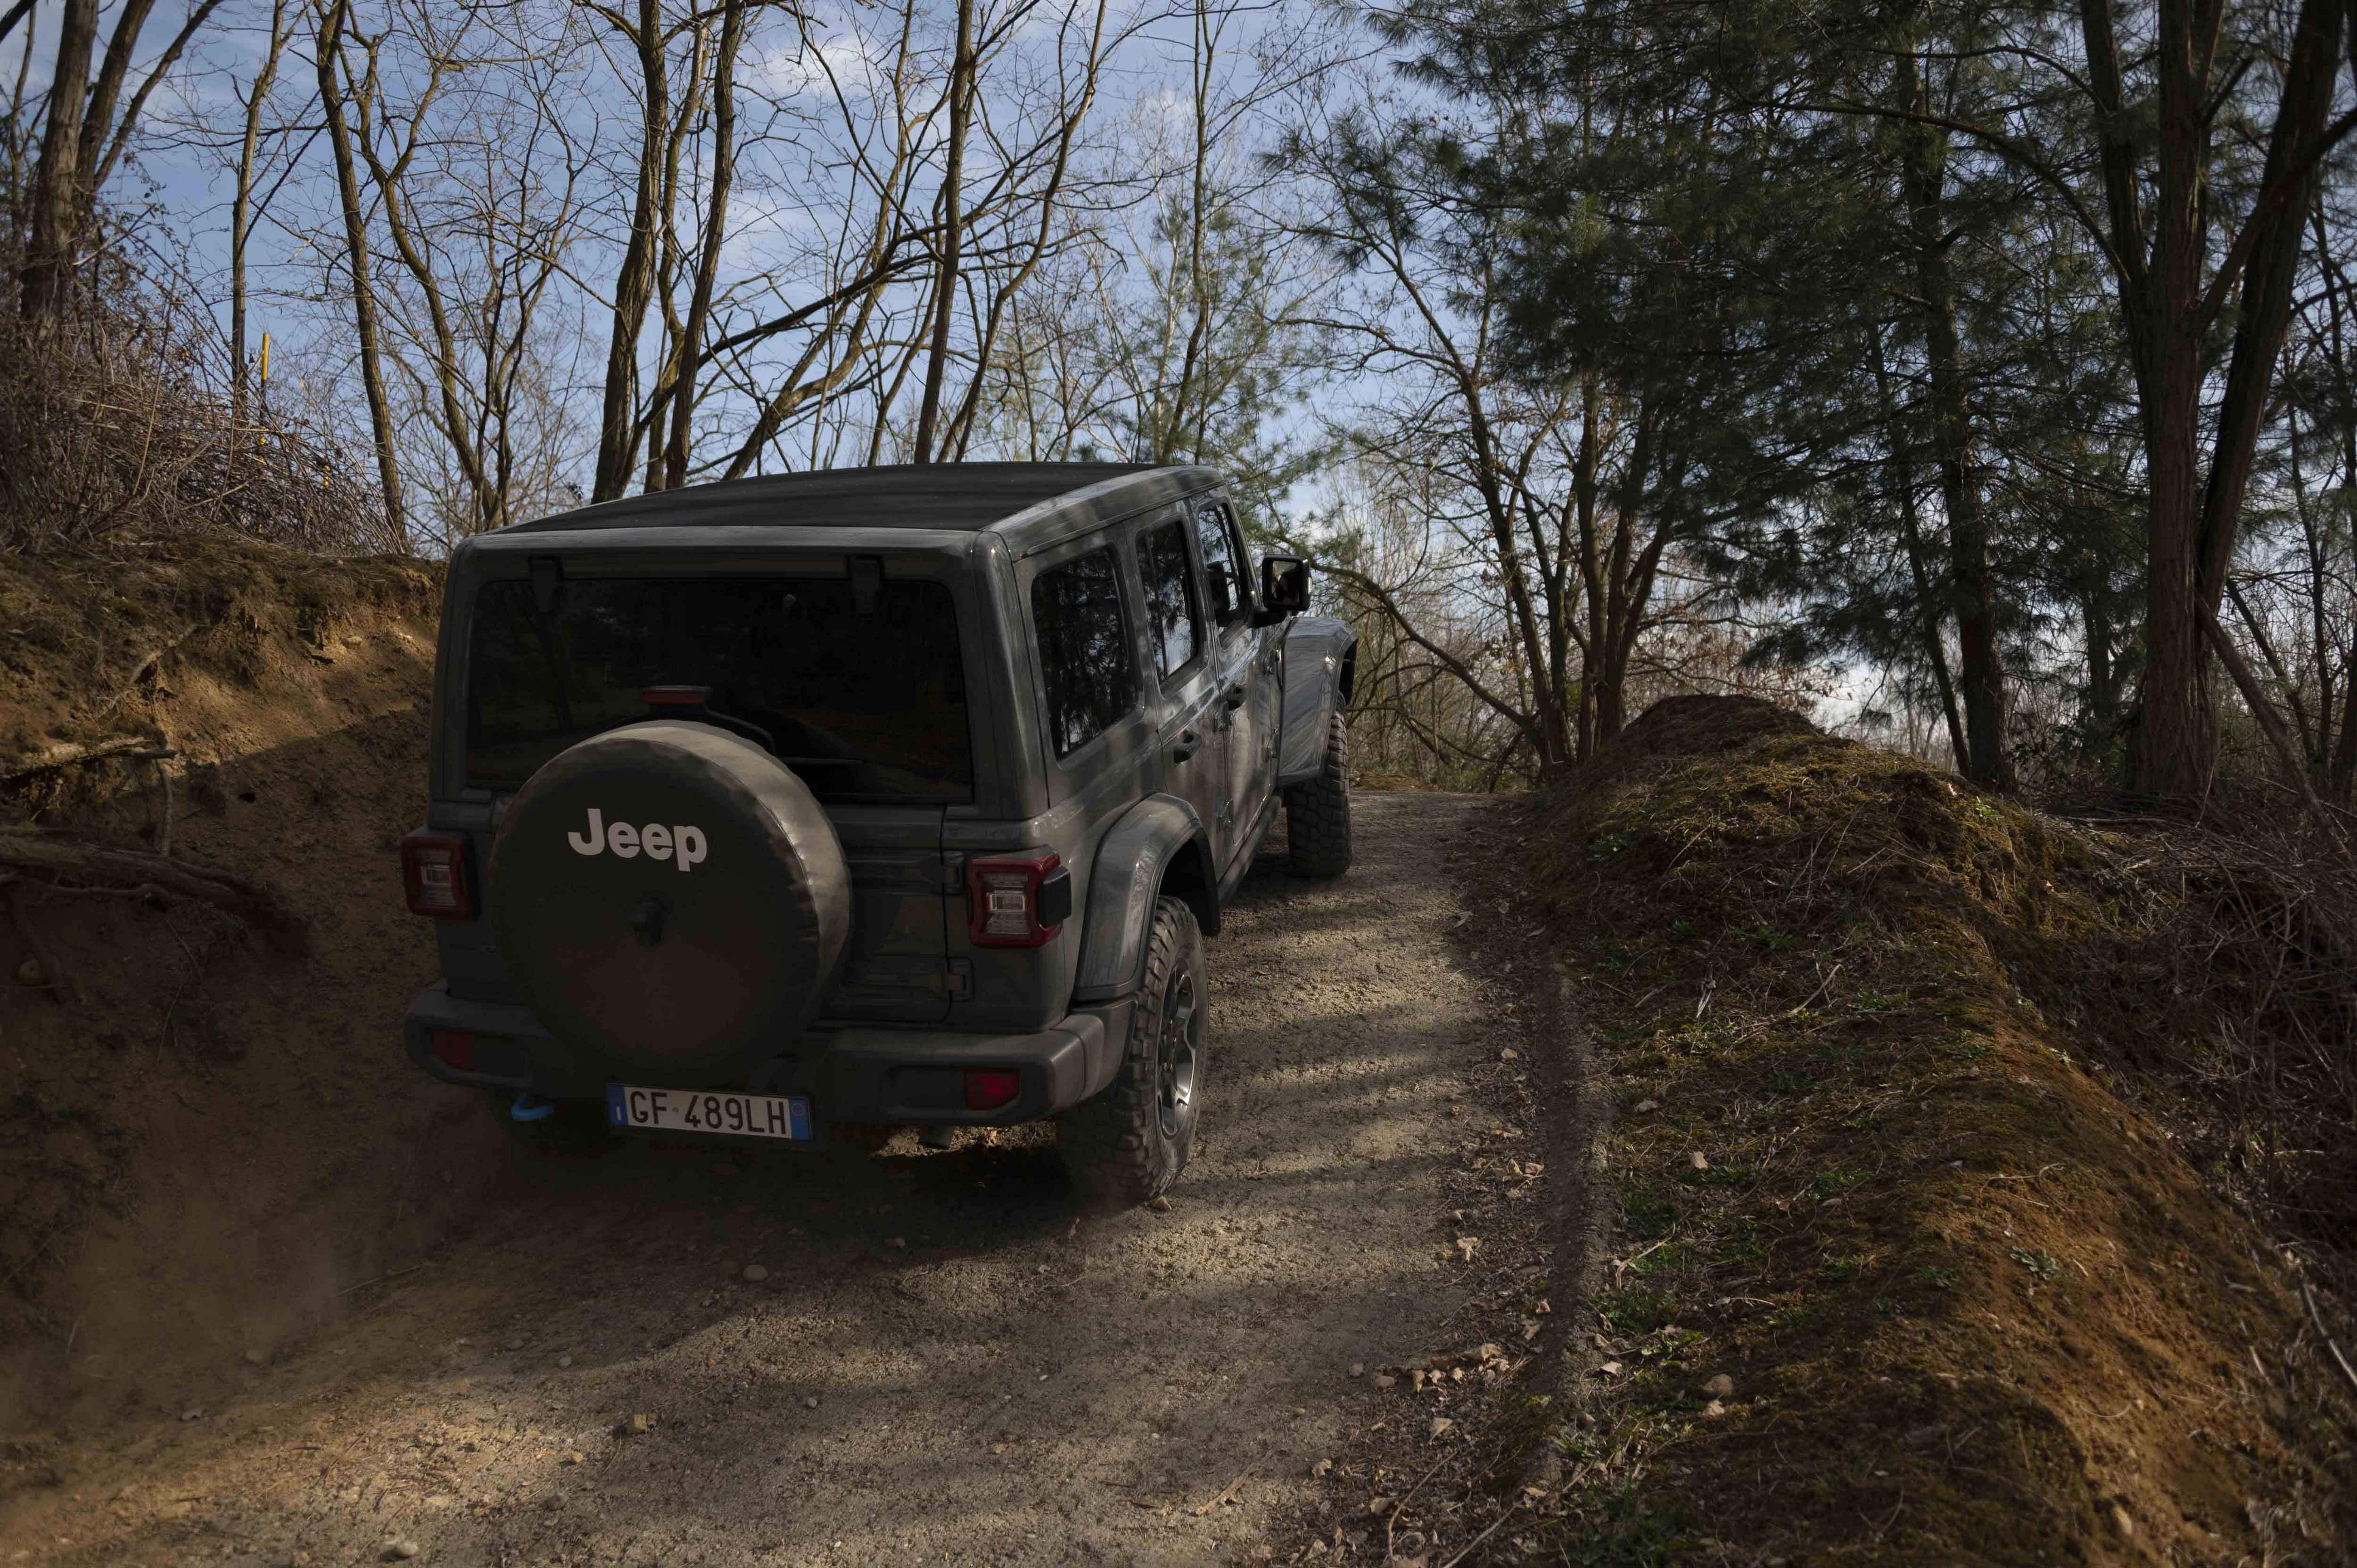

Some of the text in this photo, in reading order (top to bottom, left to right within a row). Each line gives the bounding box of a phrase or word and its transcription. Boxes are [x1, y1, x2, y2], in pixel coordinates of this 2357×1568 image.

[567, 807, 708, 872] Jeep
[630, 1091, 667, 1125] GF
[685, 1095, 786, 1134] 489LH
